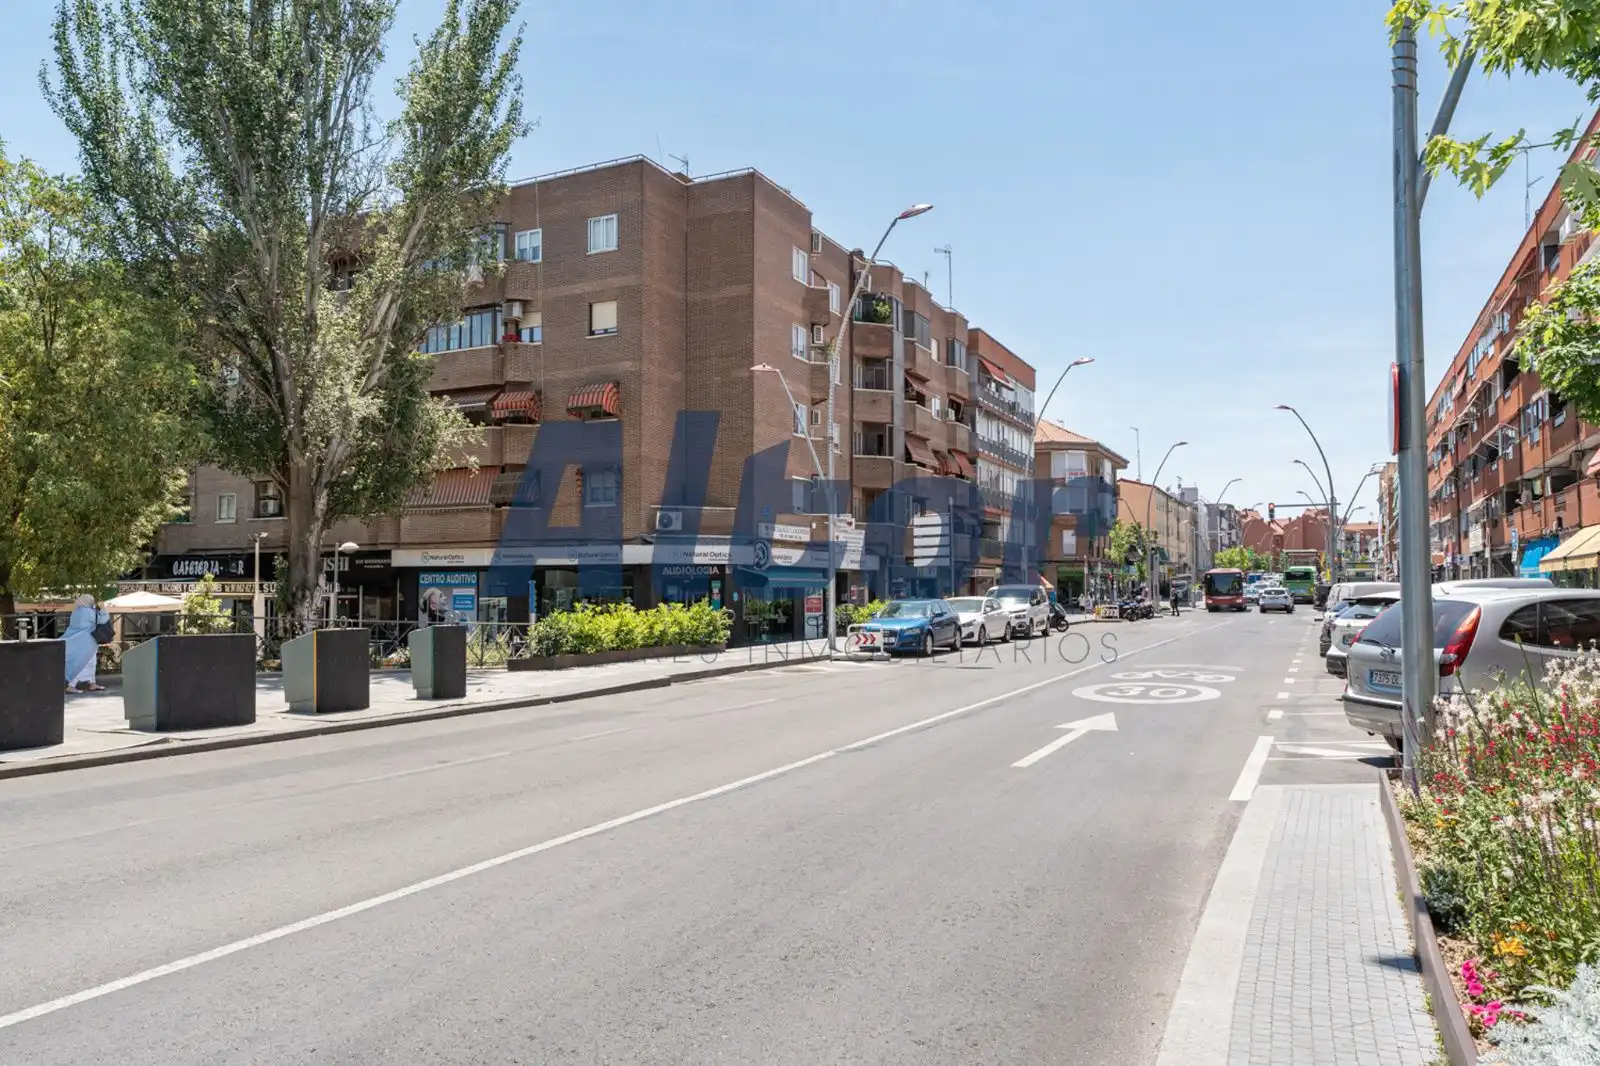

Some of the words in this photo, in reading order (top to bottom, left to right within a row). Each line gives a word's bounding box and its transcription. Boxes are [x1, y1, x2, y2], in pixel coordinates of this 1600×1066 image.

[709, 551, 732, 559] Optics
[420, 573, 446, 584] CENTRO
[446, 573, 477, 584] AUDITIVO
[1105, 686, 1188, 698] 30
